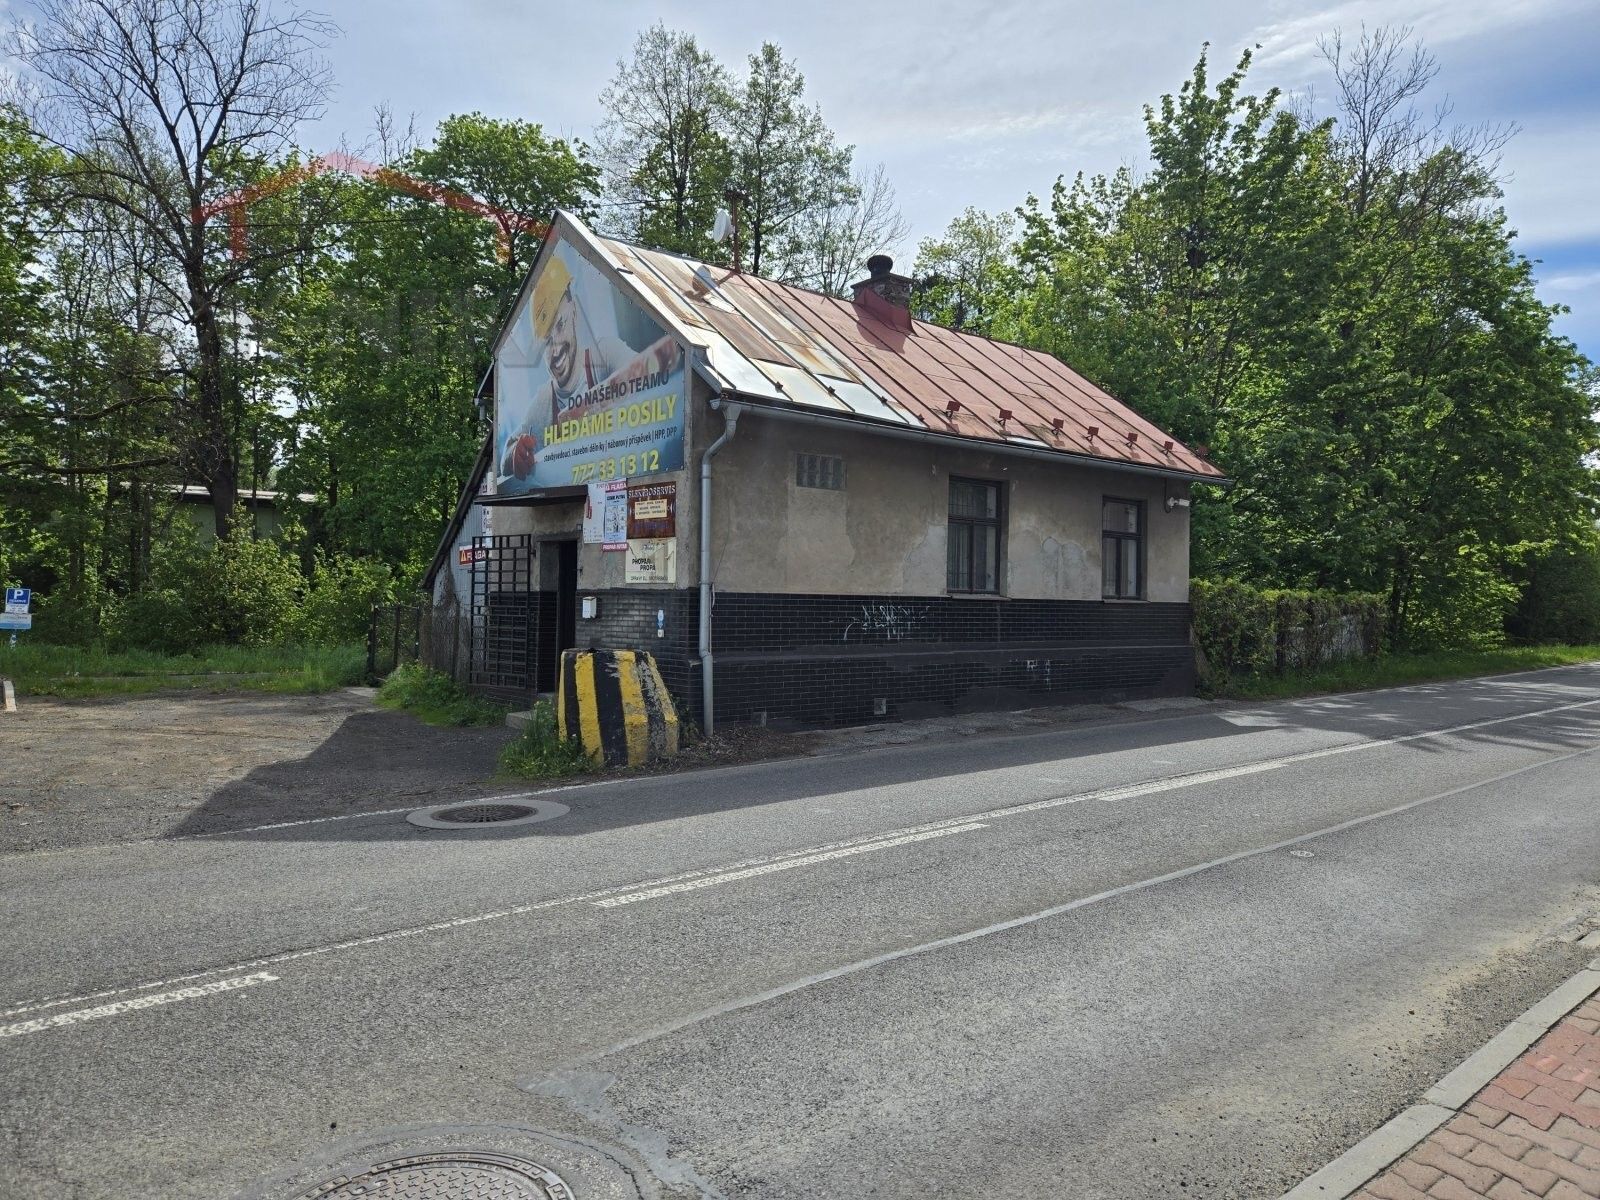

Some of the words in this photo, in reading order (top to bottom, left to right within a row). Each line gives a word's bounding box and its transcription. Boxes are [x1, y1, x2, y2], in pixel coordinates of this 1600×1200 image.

[568, 394, 583, 411] DO
[584, 381, 627, 406] NAŠEHO
[628, 370, 670, 394] TEAMU
[543, 409, 613, 447] HLEDÁME
[618, 394, 677, 428] POSILY
[571, 462, 595, 484] 777
[599, 459, 616, 481] 33
[620, 454, 637, 476] 13
[642, 449, 659, 472] 12
[14, 589, 24, 599] P
